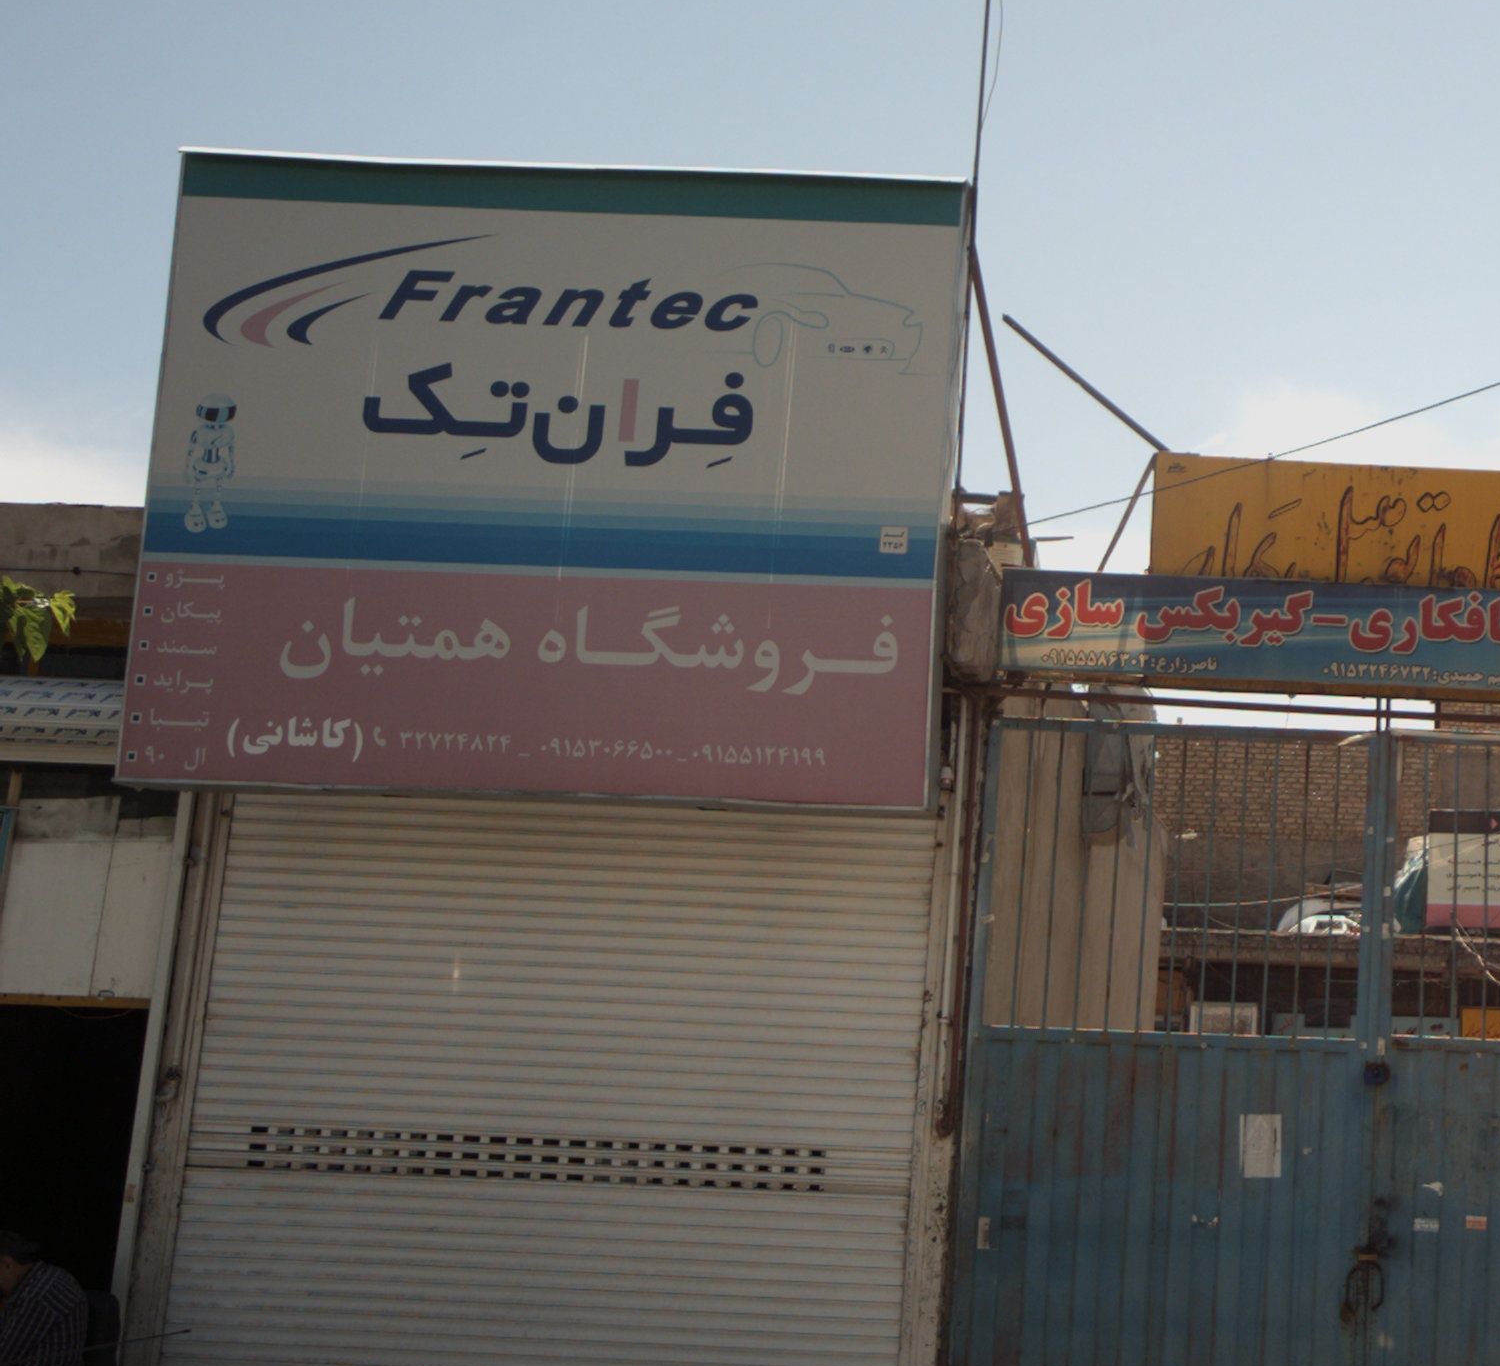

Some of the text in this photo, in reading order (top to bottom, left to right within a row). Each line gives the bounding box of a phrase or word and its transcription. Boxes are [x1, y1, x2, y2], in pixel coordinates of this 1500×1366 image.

[378, 269, 759, 332] Frantec
[164, 569, 226, 590] پژو
[160, 601, 222, 624] پیکان
[1005, 578, 1125, 641] سازی
[156, 638, 218, 655] سمند
[279, 596, 901, 696] فروشگاه همتیان
[153, 670, 214, 694] پراید
[150, 708, 210, 731] تیبا
[227, 716, 363, 762] (کاشانی)
